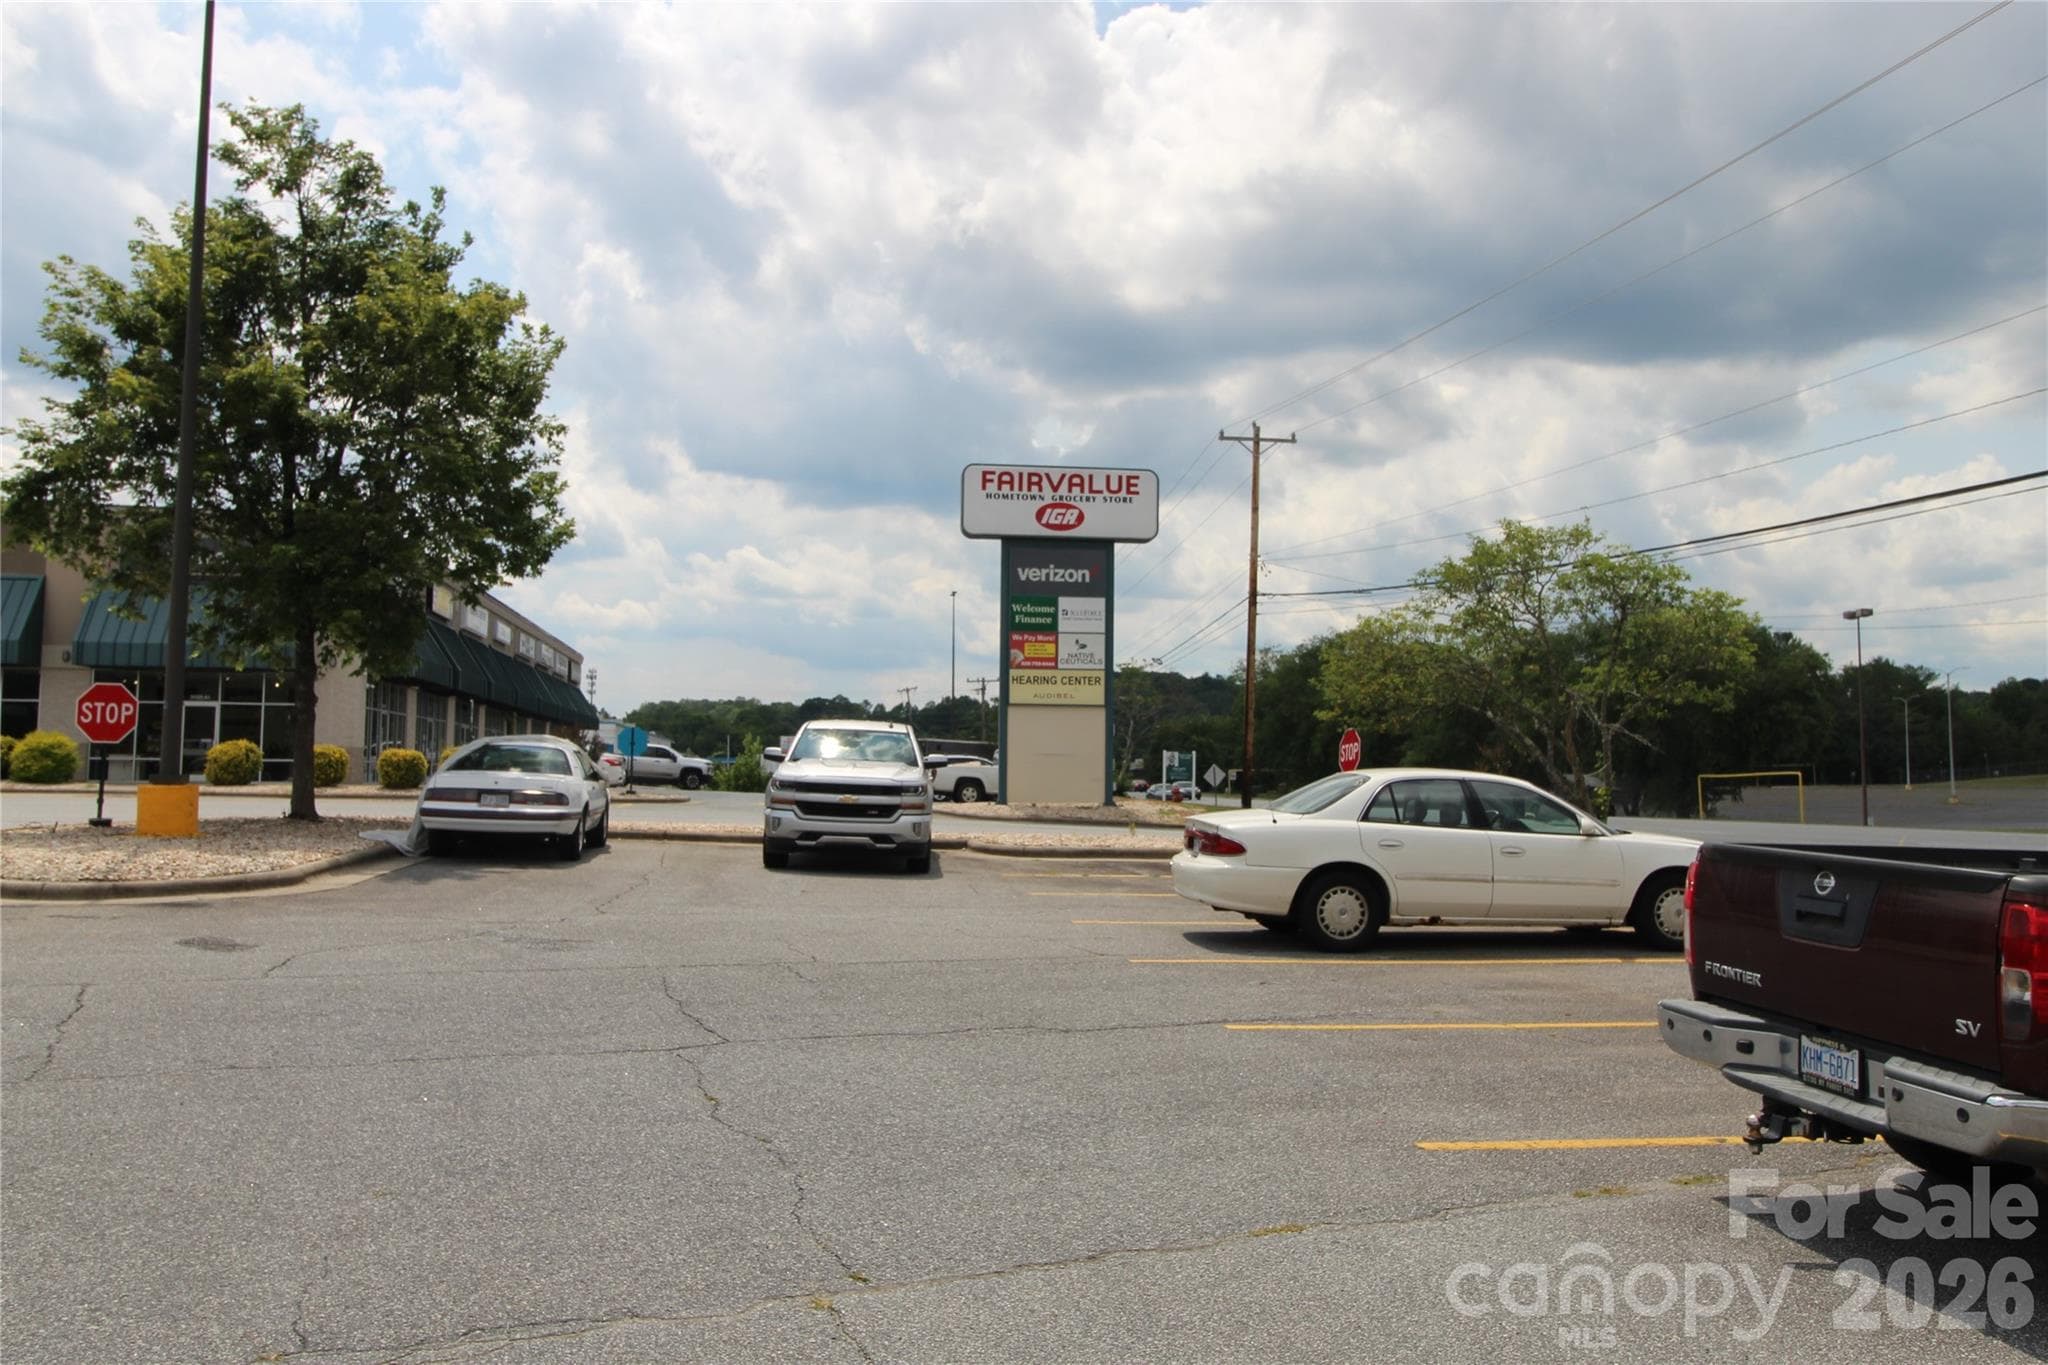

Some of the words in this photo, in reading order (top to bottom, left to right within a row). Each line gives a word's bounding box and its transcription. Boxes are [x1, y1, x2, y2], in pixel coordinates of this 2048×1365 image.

[981, 470, 1140, 495] FAIRVALUE
[985, 492, 1045, 502] HOMETOWN
[1051, 494, 1097, 503] GROCERY
[1102, 495, 1134, 504] STORE
[1040, 507, 1080, 525] IGA
[1016, 564, 1091, 583] verizon
[1011, 603, 1055, 613] Welcome
[1015, 614, 1053, 624] Finance
[1023, 634, 1036, 642] Pay
[1059, 657, 1104, 666] CEUTICALS
[1012, 675, 1058, 685] HEARING
[1060, 676, 1102, 686] CENTER
[80, 702, 134, 724] STOP
[1340, 742, 1359, 763] STOP
[1704, 960, 1762, 987] FRONTIER
[1955, 1018, 1981, 1038] SV
[1802, 1045, 1857, 1083] KHM-6871
